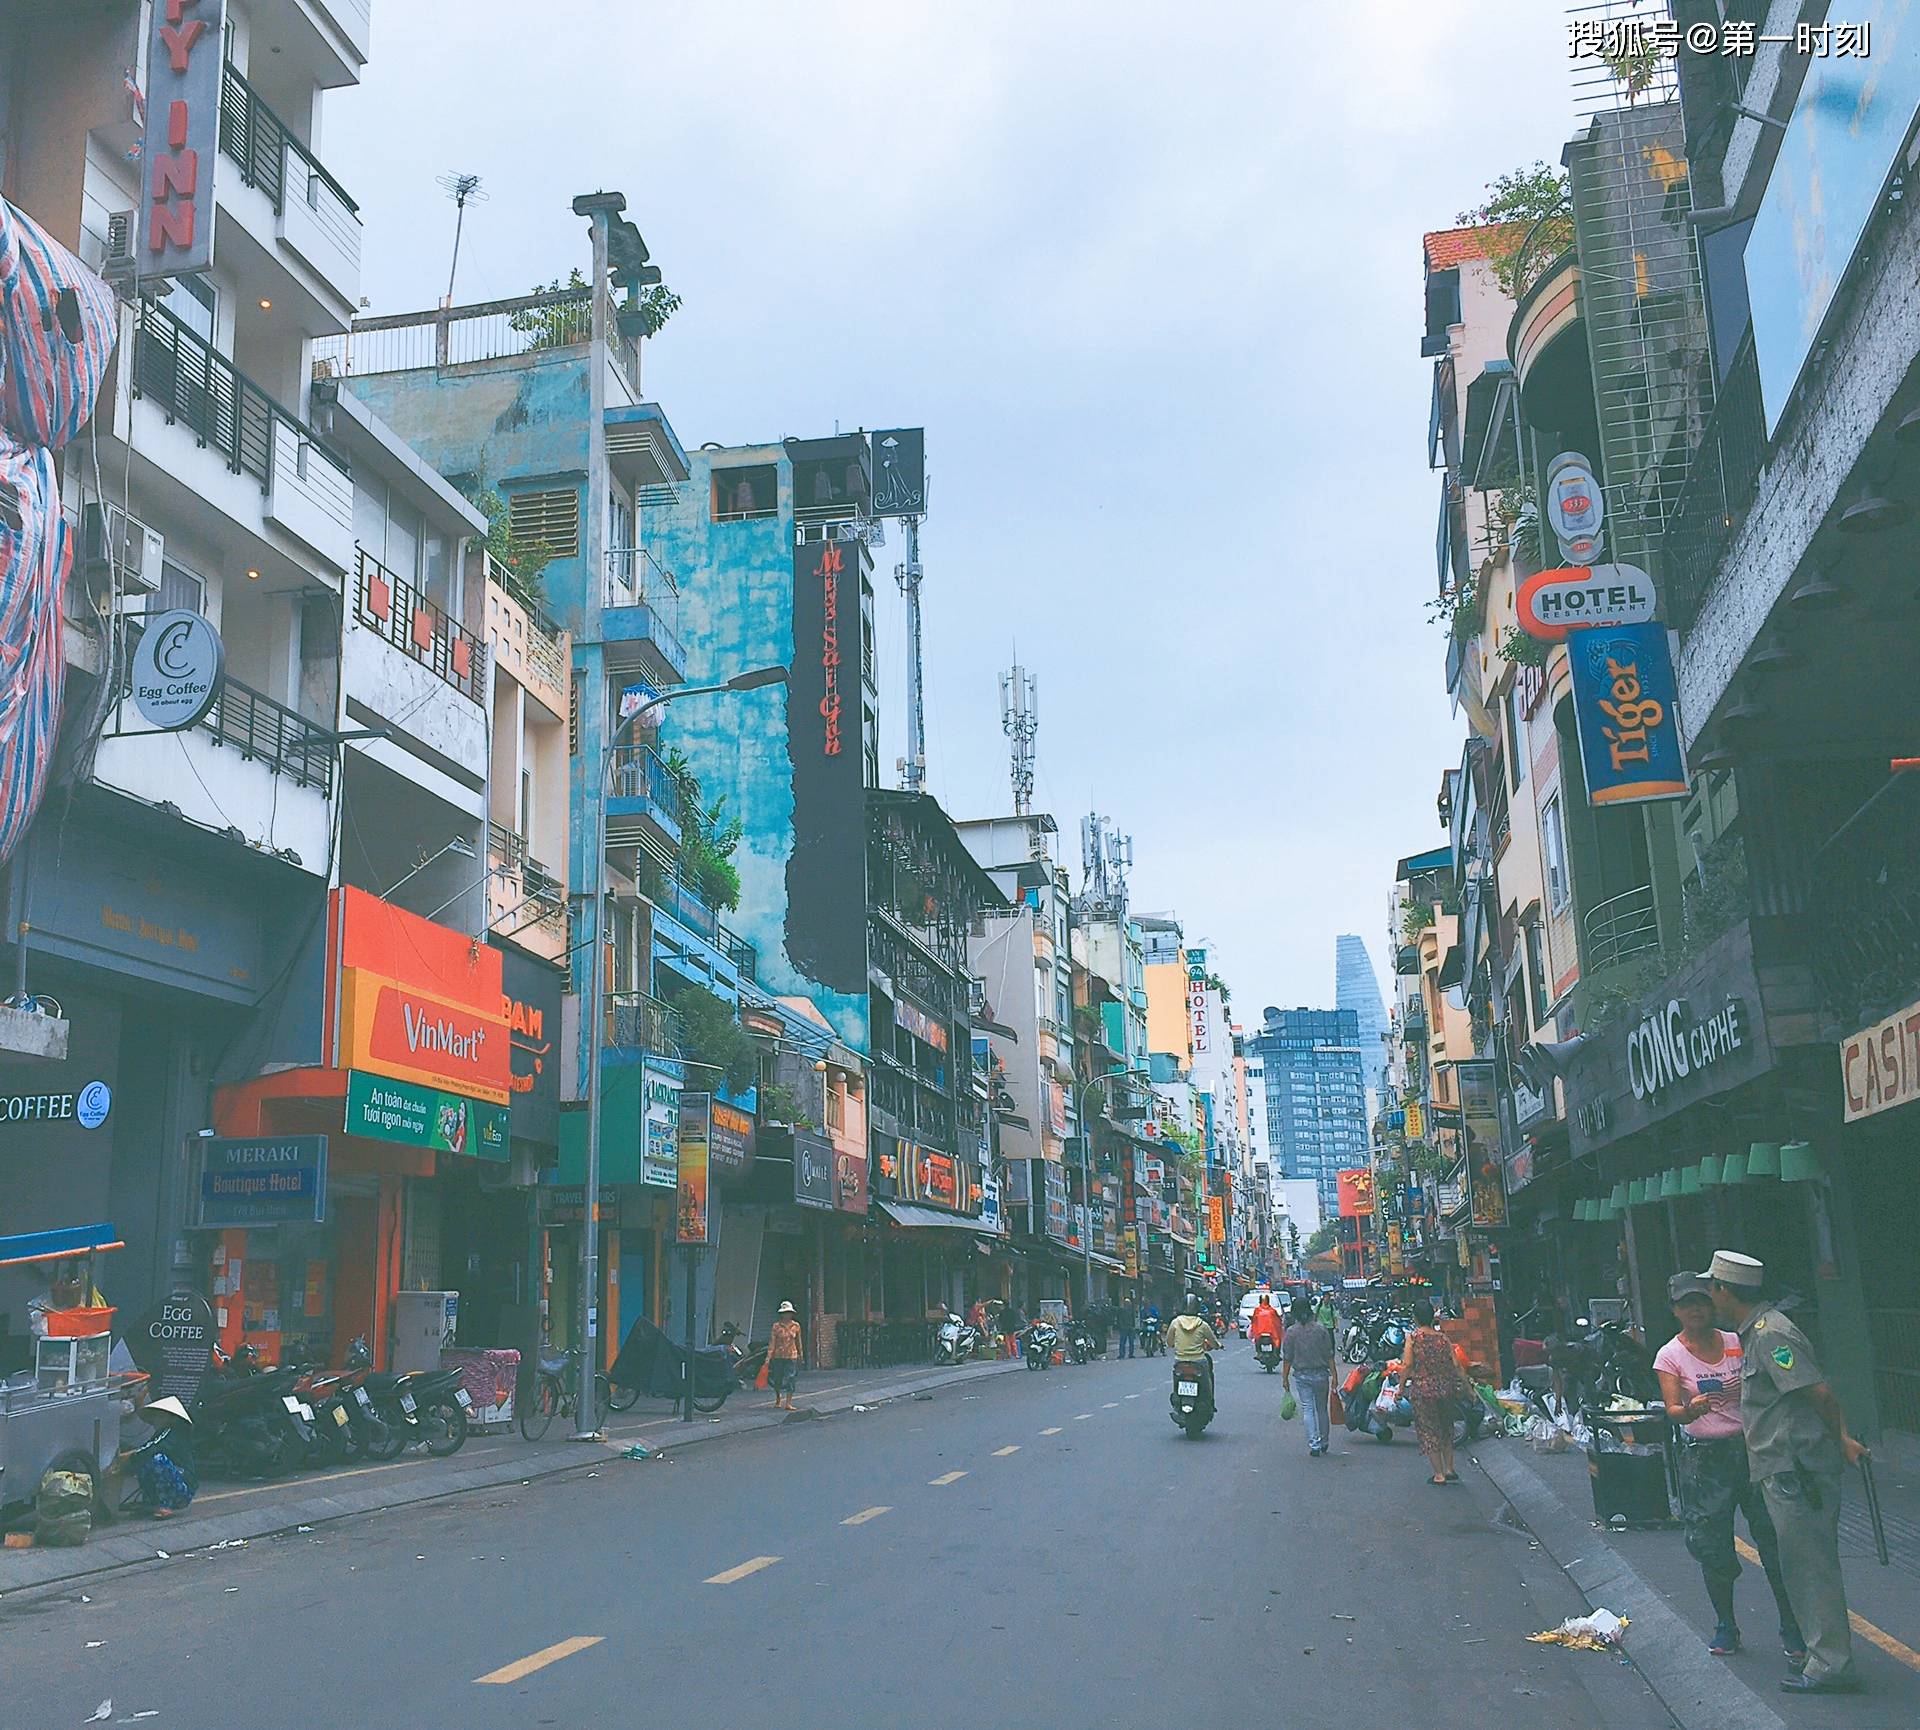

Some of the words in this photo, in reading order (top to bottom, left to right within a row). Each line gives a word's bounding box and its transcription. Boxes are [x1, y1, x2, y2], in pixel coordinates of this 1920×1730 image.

[150, 100, 198, 250] INN
[1541, 585, 1646, 612] HOTEL
[1543, 603, 1646, 619] RESTAURANT
[139, 686, 163, 699] Egg
[166, 682, 207, 695] Coffee
[1597, 656, 1663, 772] Tiger
[1191, 981, 1208, 1052] HOTEL
[371, 1087, 384, 1106] An
[381, 1111, 402, 1130] ngon
[226, 1146, 300, 1164] MERAKI
[214, 1174, 267, 1196] Boutique
[271, 1170, 303, 1192] Hotel
[1211, 1208, 1222, 1241] HOTEL
[162, 1305, 192, 1321] EGG
[149, 1322, 203, 1339] COFFEE
